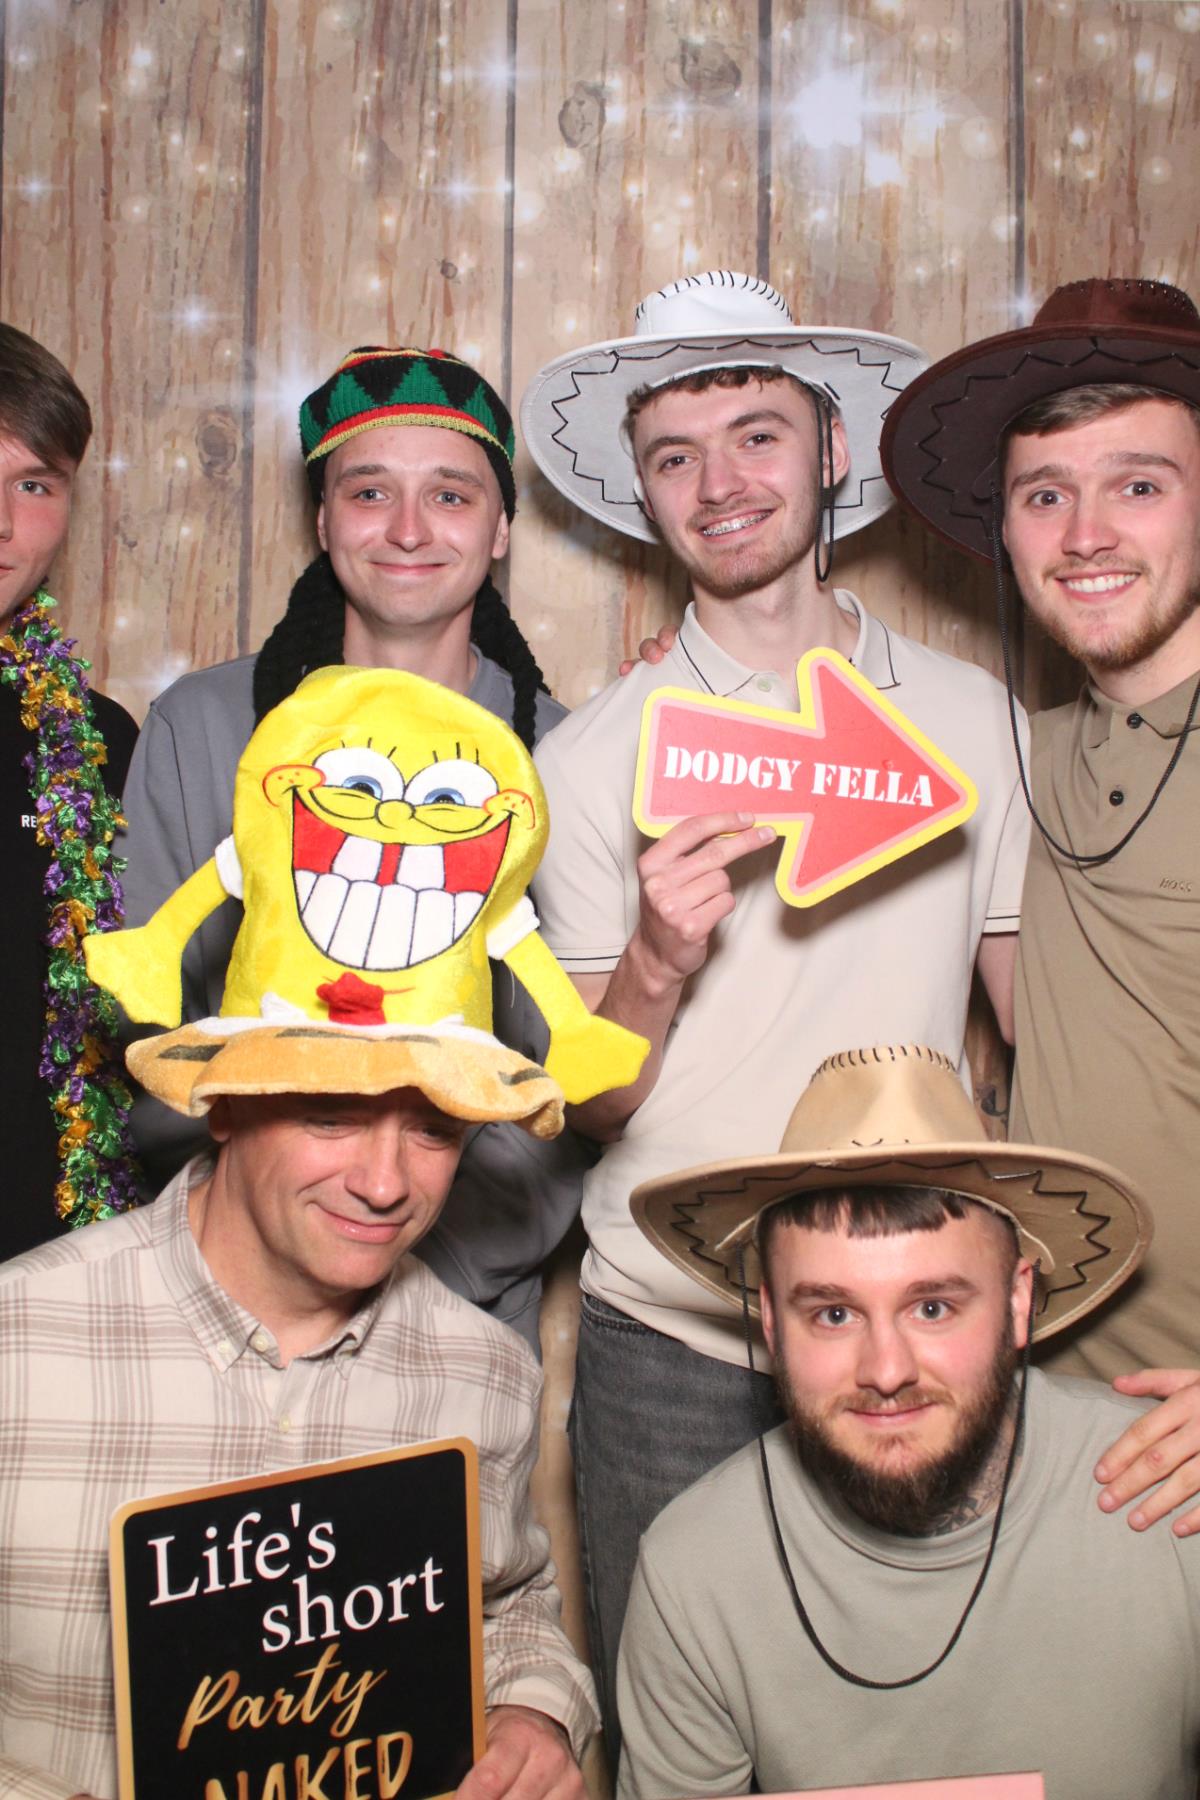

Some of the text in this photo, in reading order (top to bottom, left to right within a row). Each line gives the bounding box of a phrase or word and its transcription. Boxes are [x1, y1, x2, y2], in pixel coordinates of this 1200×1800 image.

[663, 746, 935, 807] DODGY FELLA
[147, 1503, 336, 1606] Life's
[261, 1556, 445, 1653] short
